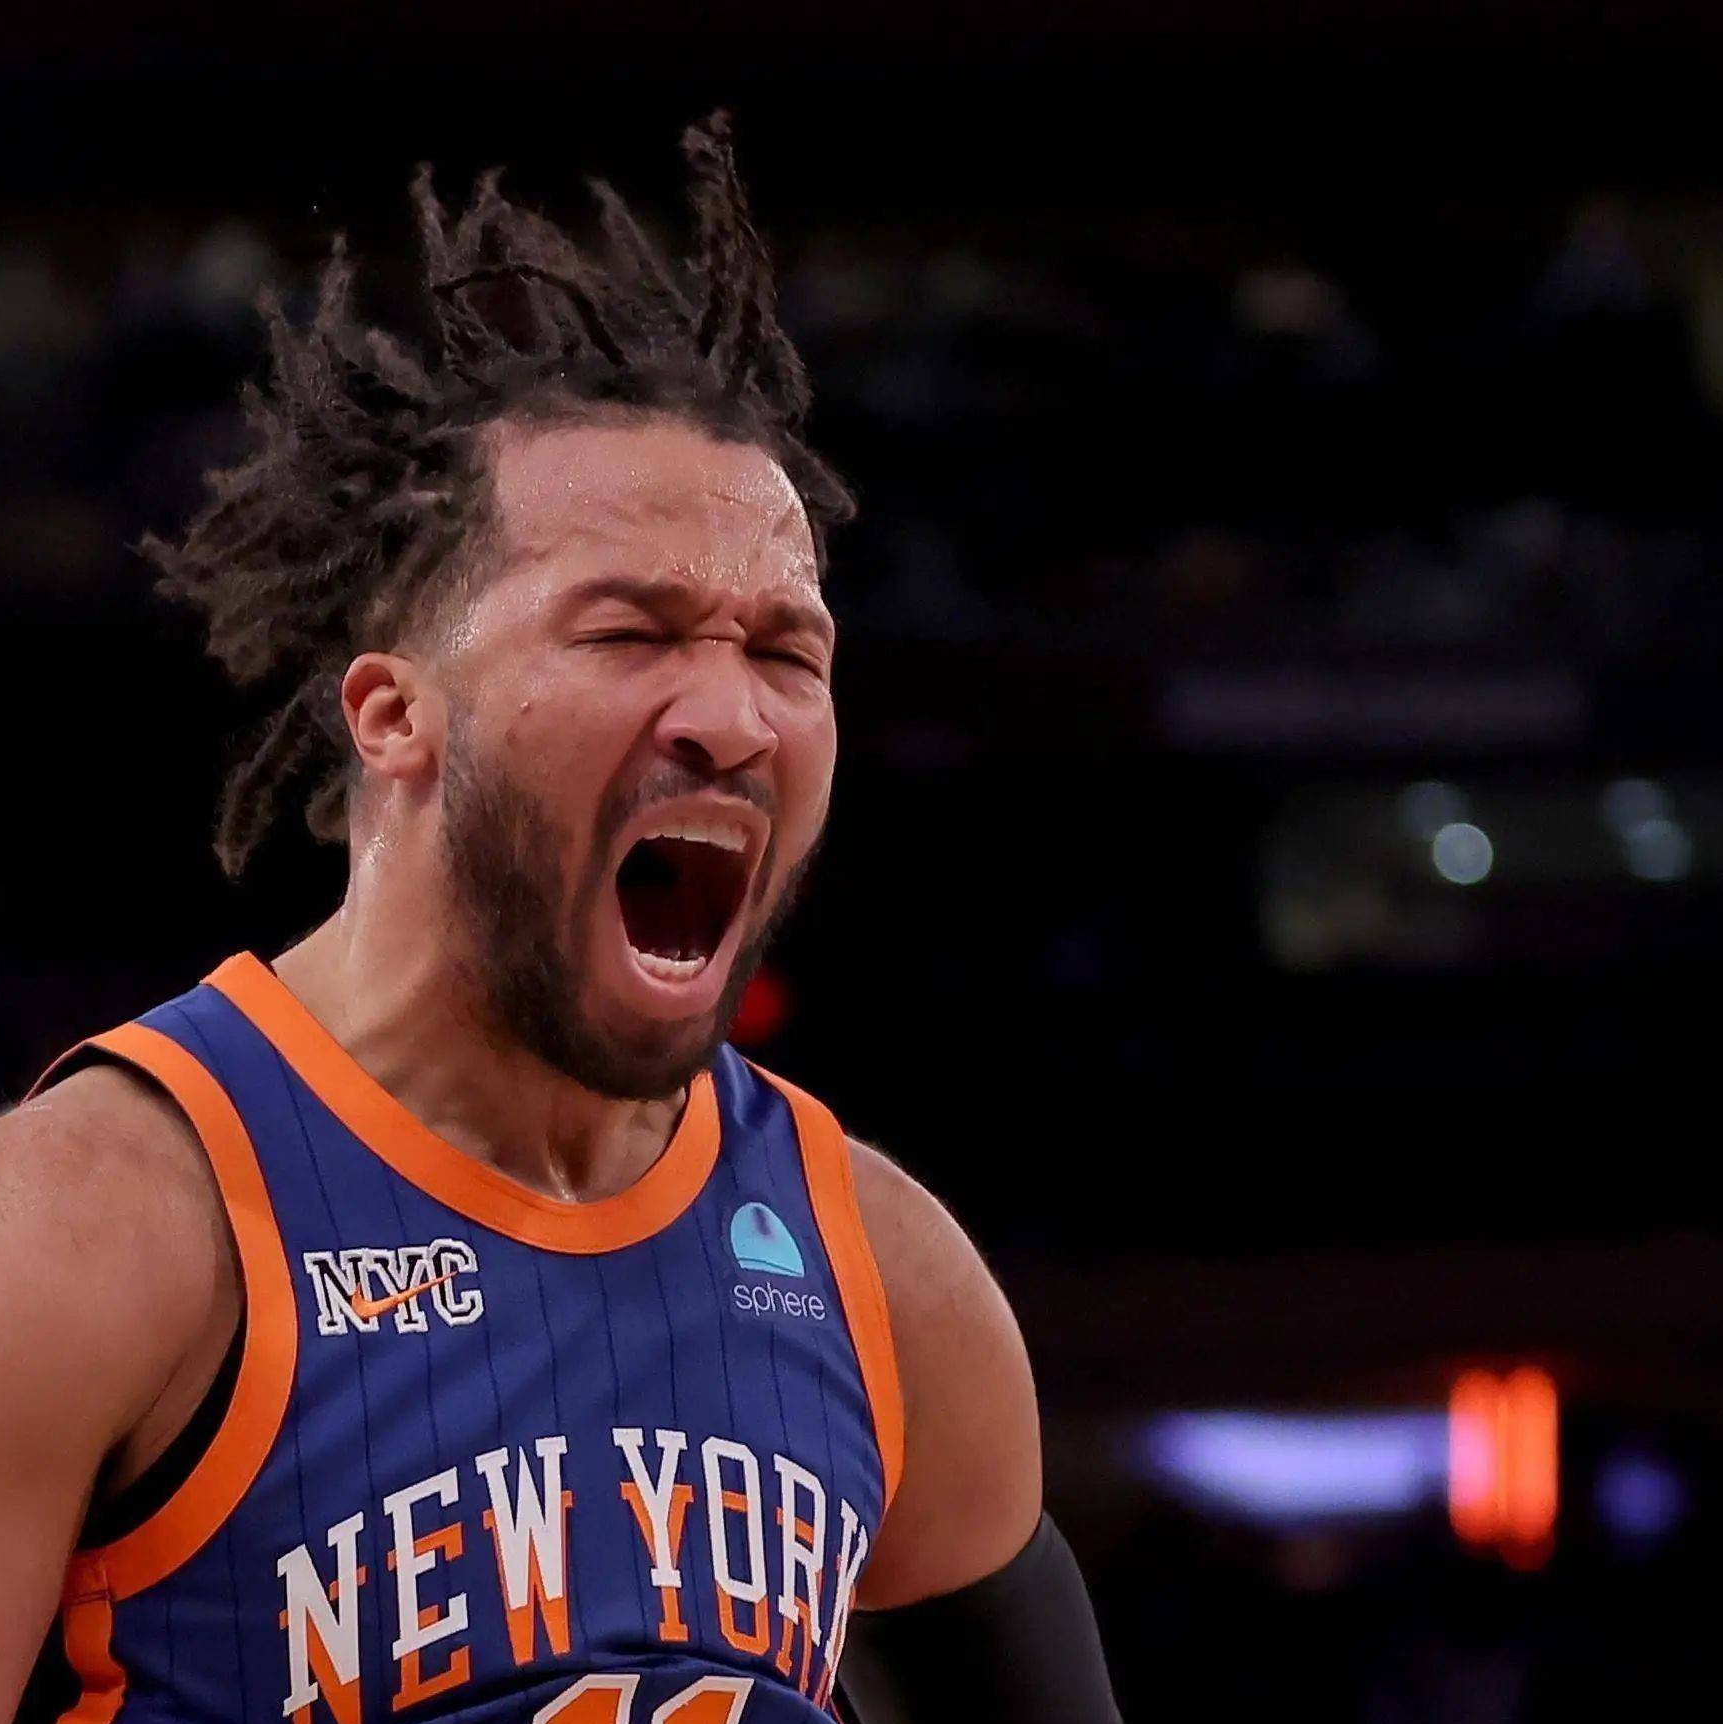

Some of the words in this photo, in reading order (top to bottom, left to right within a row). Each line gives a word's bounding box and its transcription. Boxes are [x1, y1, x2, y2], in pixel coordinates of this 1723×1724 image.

[303, 1238, 485, 1336] NYC
[733, 1282, 826, 1321] sphere
[611, 1426, 869, 1706] YORK
